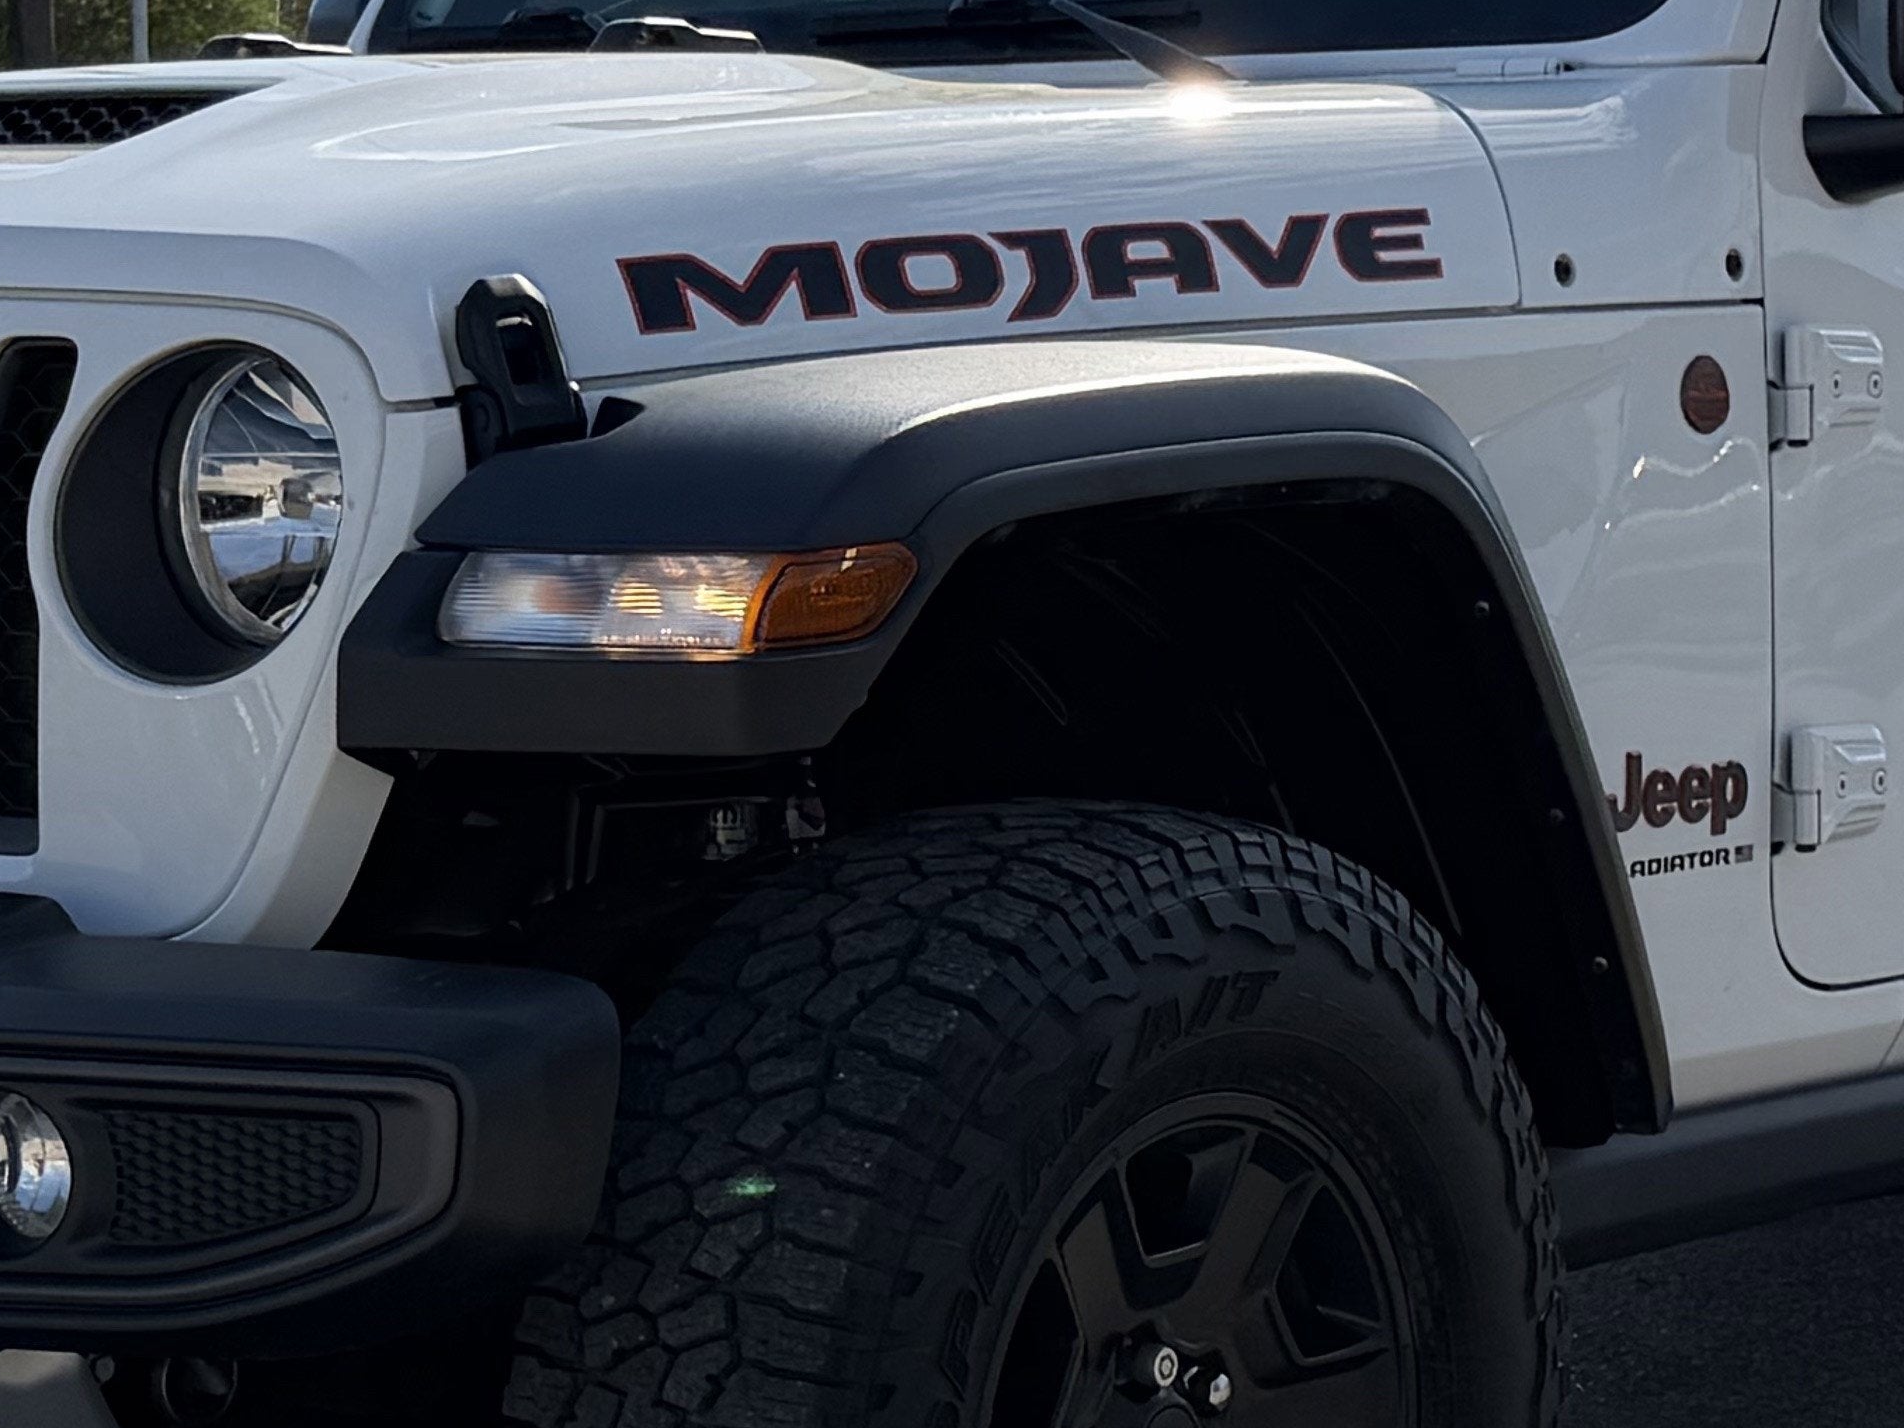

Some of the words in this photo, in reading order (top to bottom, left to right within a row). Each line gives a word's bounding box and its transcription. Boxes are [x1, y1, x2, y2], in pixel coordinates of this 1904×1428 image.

[615, 207, 1445, 335] MOJAVE
[1605, 750, 1749, 836] Jeep
[1629, 847, 1731, 878] ADIATOR
